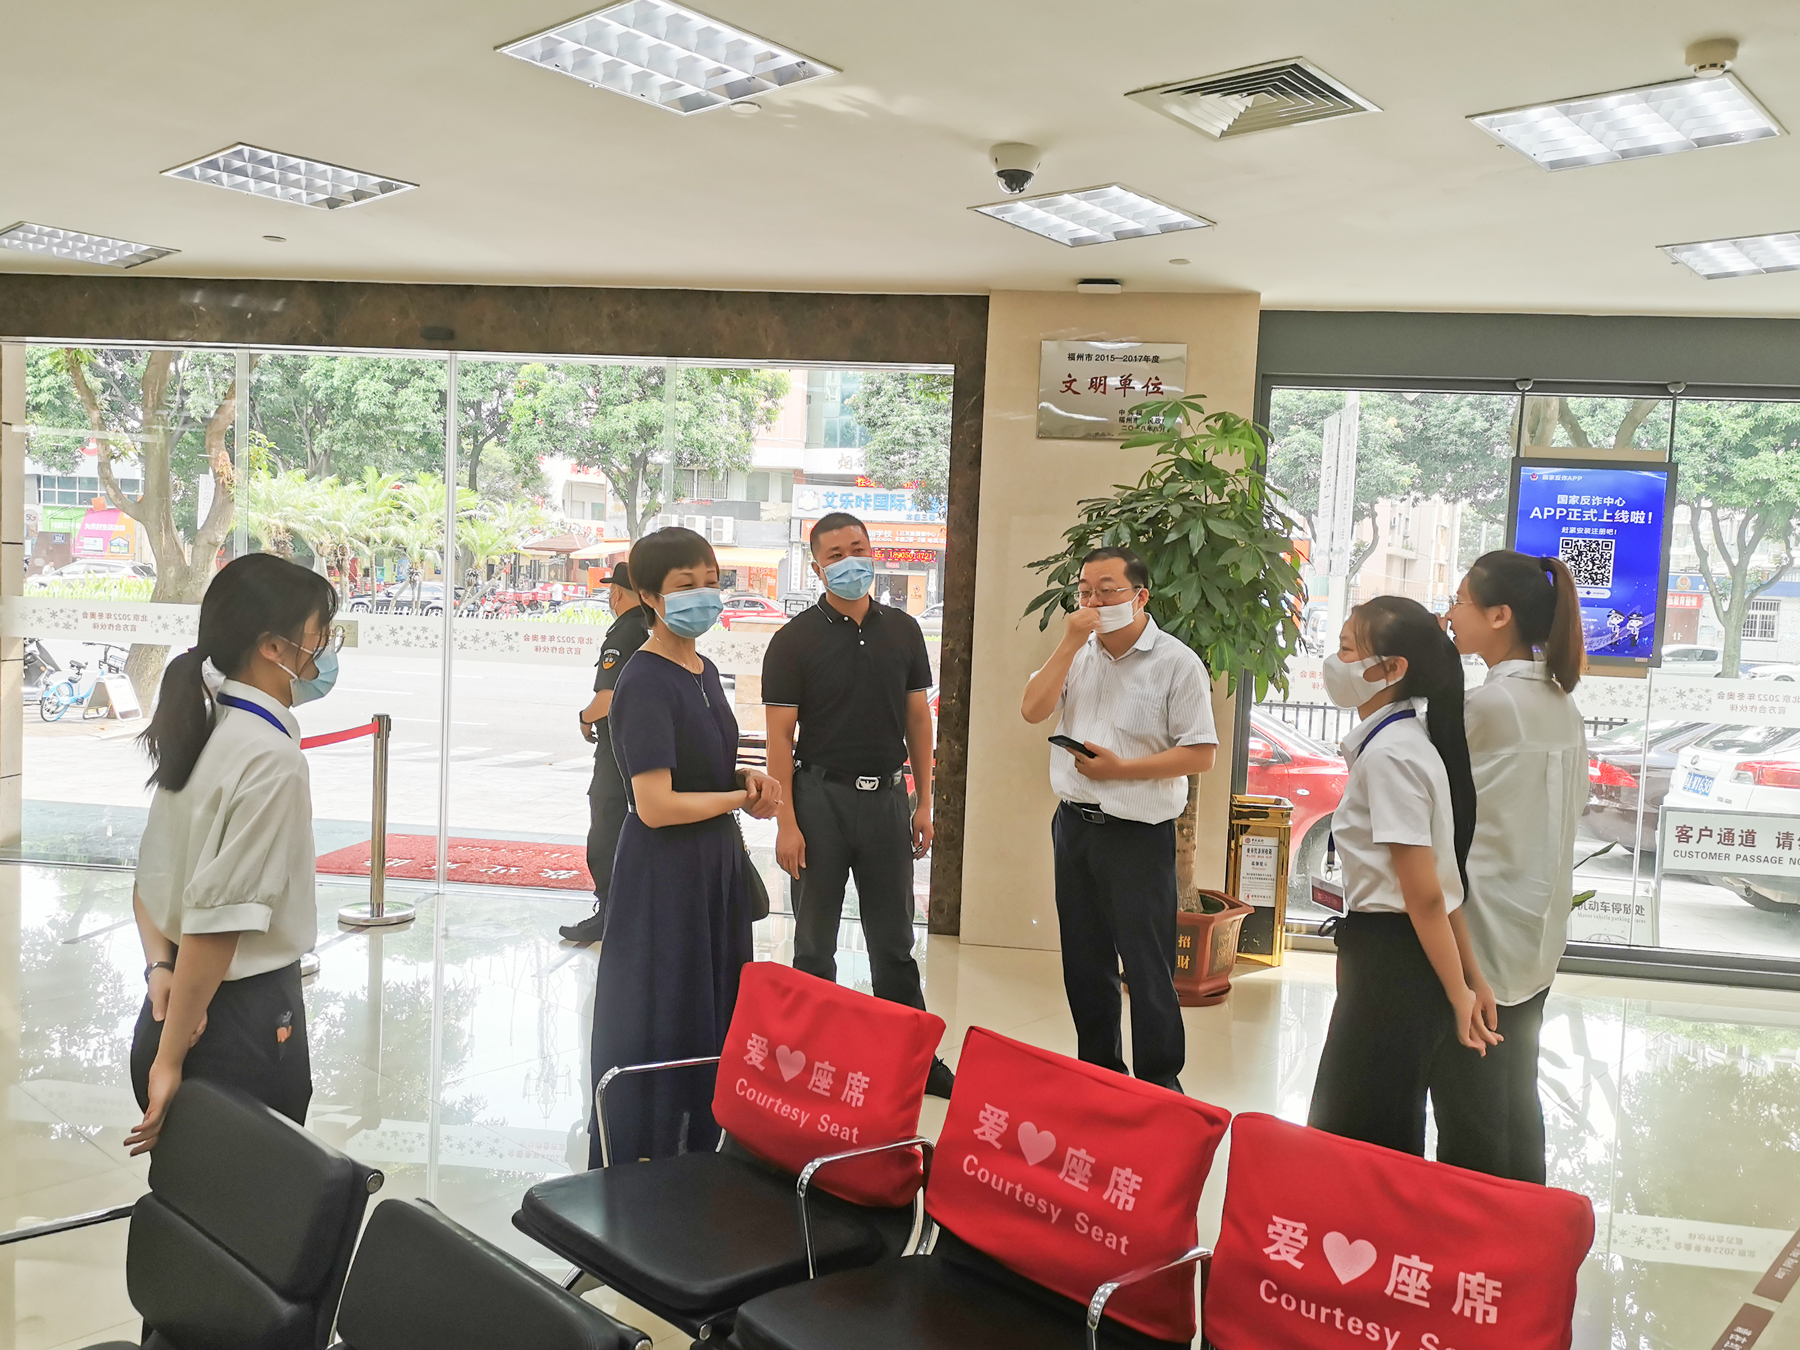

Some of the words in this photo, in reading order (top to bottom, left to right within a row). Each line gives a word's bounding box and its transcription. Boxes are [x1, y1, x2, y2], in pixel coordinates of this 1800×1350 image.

[1059, 373, 1164, 397] 文明单位
[822, 491, 948, 513] 艾乐咔国际
[1557, 494, 1626, 507] 国家反诈中心
[1675, 825, 1757, 848] 客户通道
[1776, 831, 1800, 851] 请
[1673, 849, 1730, 861] CUSTOMER
[1735, 853, 1783, 864] PASSAGE
[1578, 900, 1645, 916] 机动车停放处
[735, 1077, 811, 1128] Courtesy
[817, 1113, 860, 1144] Seat
[962, 1154, 1062, 1224] Courtesy
[1074, 1211, 1130, 1256] Seat
[1259, 1279, 1401, 1350] Courtesy
